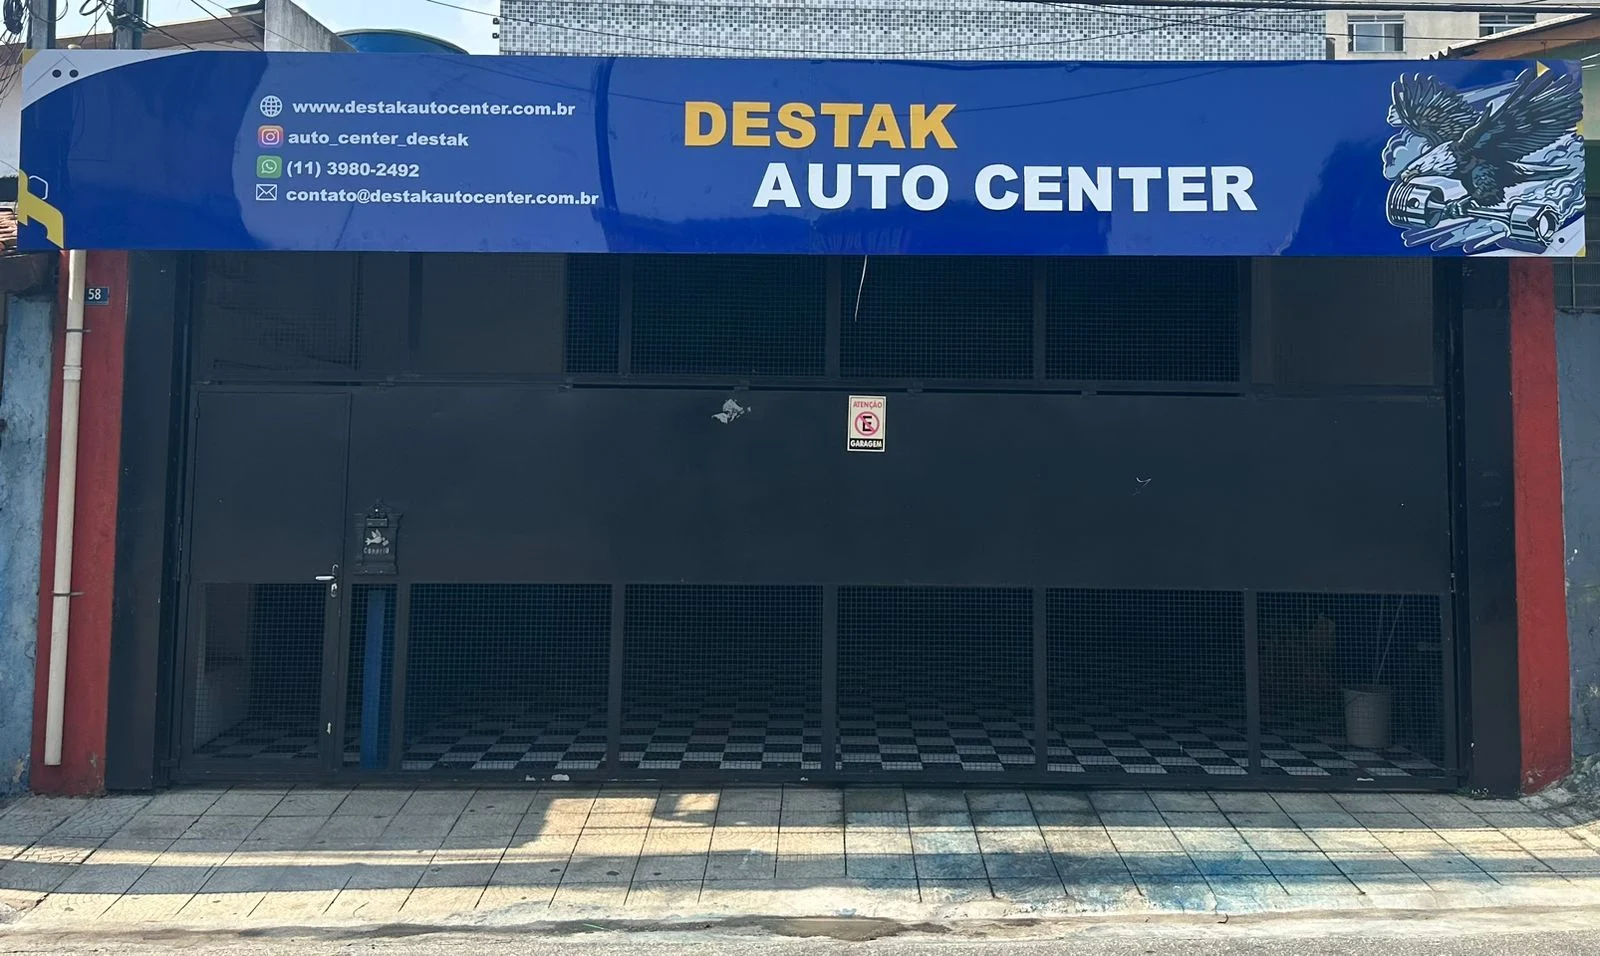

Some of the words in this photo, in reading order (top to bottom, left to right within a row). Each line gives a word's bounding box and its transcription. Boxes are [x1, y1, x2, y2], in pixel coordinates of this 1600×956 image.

[292, 100, 576, 116] www.destakautocenter.com.br
[684, 101, 958, 148] DESTAK
[288, 131, 469, 147] auto_center_destak
[286, 161, 321, 178] (11)
[327, 162, 420, 177] 3980-2492
[752, 162, 949, 211] AUTO
[974, 164, 1258, 212] CENTER
[286, 189, 599, 205] contato@destakautocenter.com.br
[88, 288, 101, 300] 58
[853, 400, 882, 409] ATENÇÃO
[850, 440, 882, 448] GARAGEM
